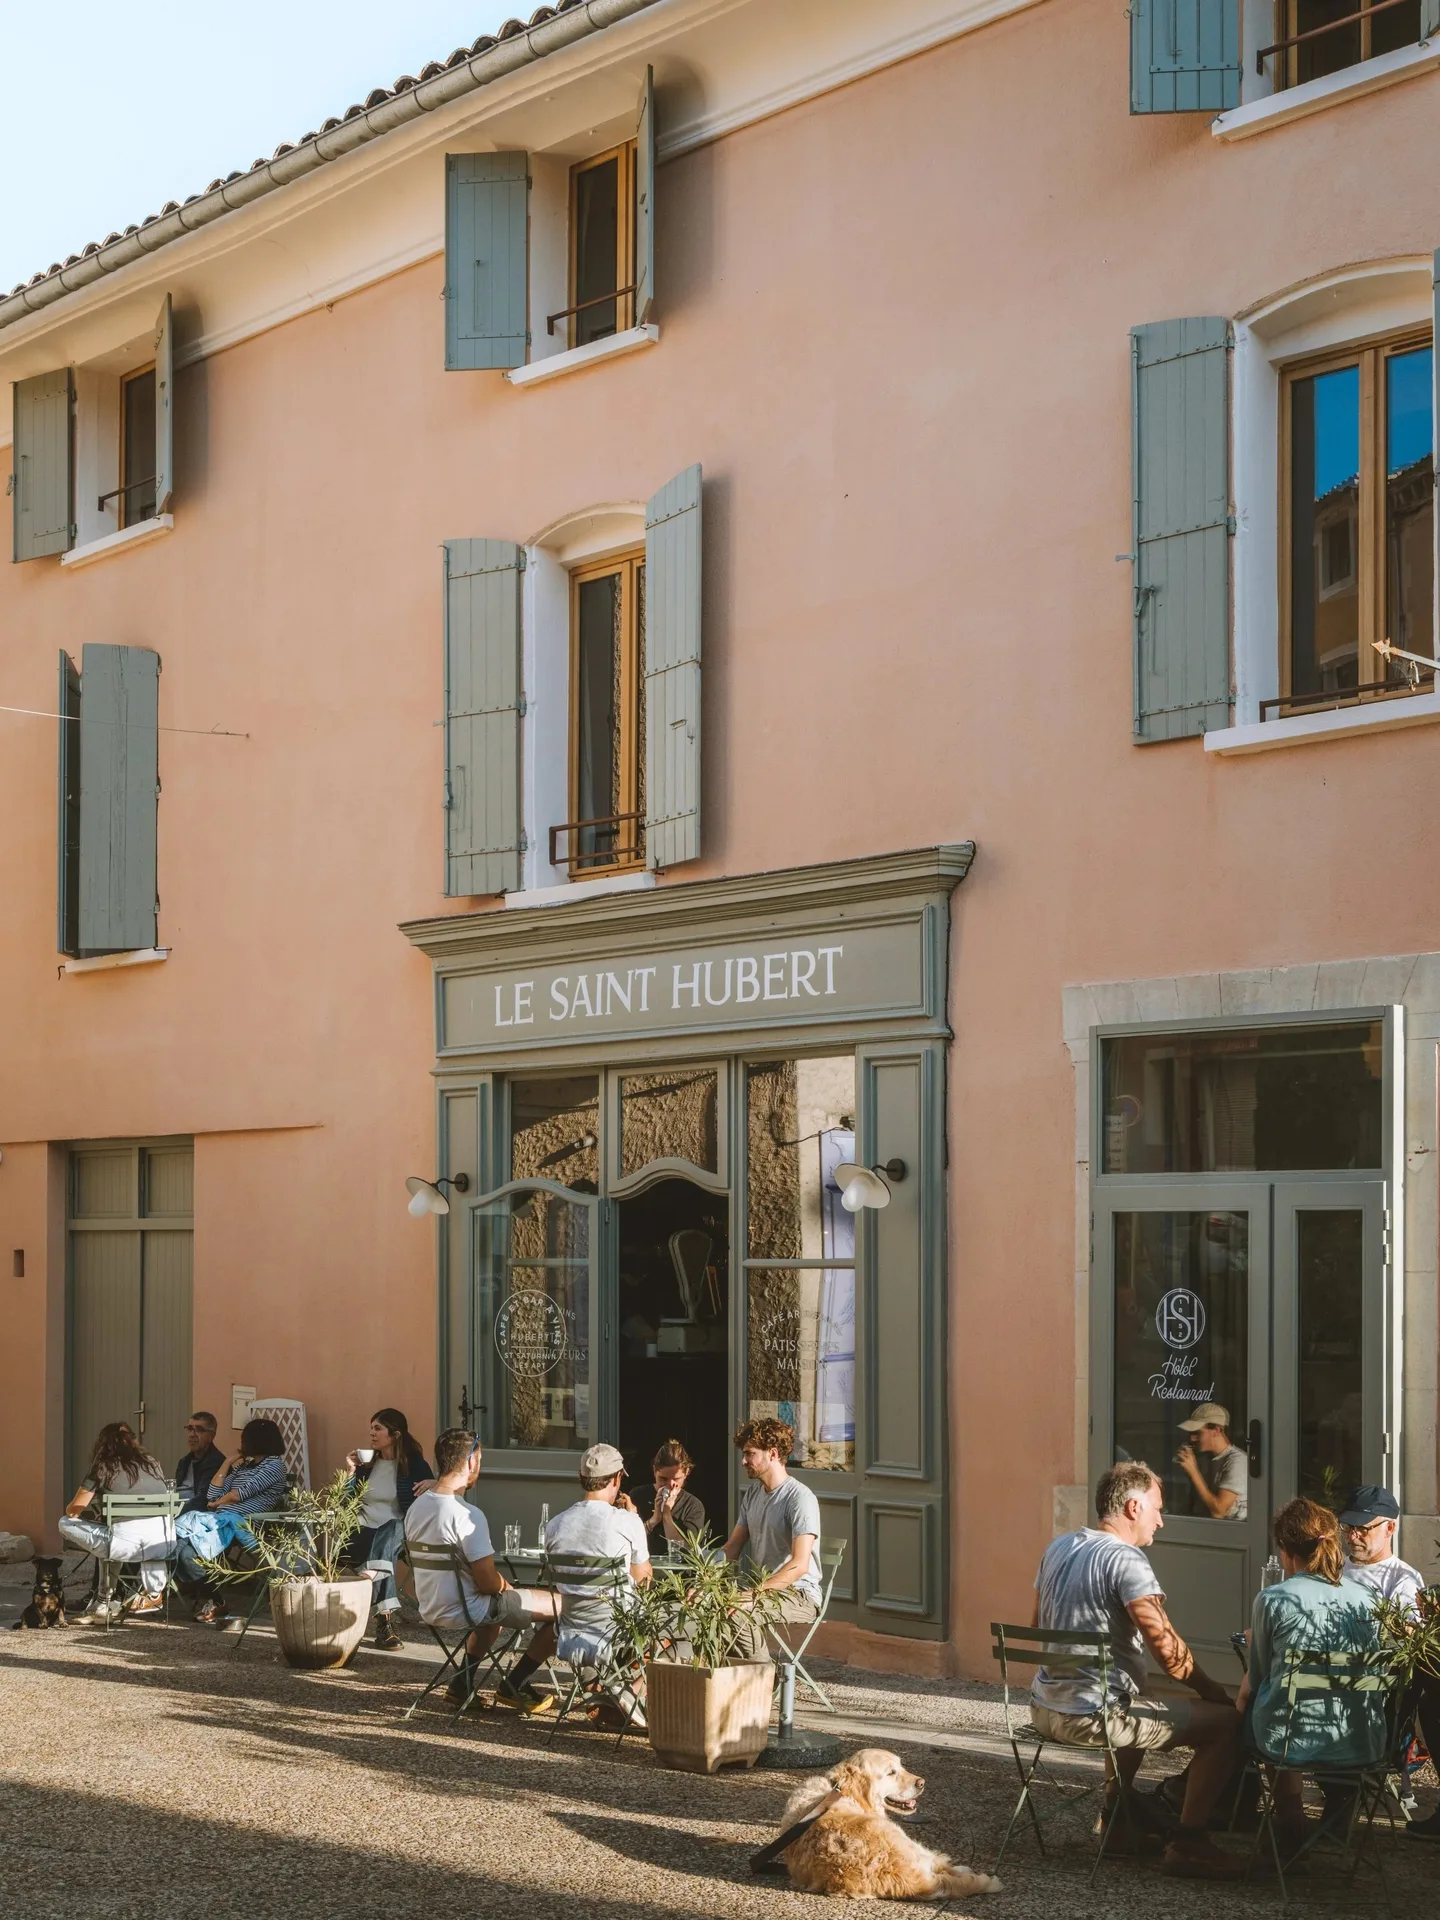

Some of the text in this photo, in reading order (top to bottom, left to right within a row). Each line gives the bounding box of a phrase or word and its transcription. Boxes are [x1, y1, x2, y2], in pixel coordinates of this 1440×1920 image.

[494, 945, 843, 1027] LE SAINT HUBERT
[500, 1313, 509, 1346] CAFÉ
[508, 1300, 520, 1312] ET
[522, 1296, 544, 1305] BAR
[552, 1316, 560, 1346] VINS
[515, 1321, 545, 1329] SAINT
[761, 1311, 785, 1334] CAFÉ
[510, 1333, 549, 1342] HUBERT
[514, 1361, 546, 1370] LES APT
[516, 1352, 557, 1360] SATURNIN
[1162, 1354, 1198, 1376] Hôtel
[1147, 1373, 1215, 1401] Restaurant
